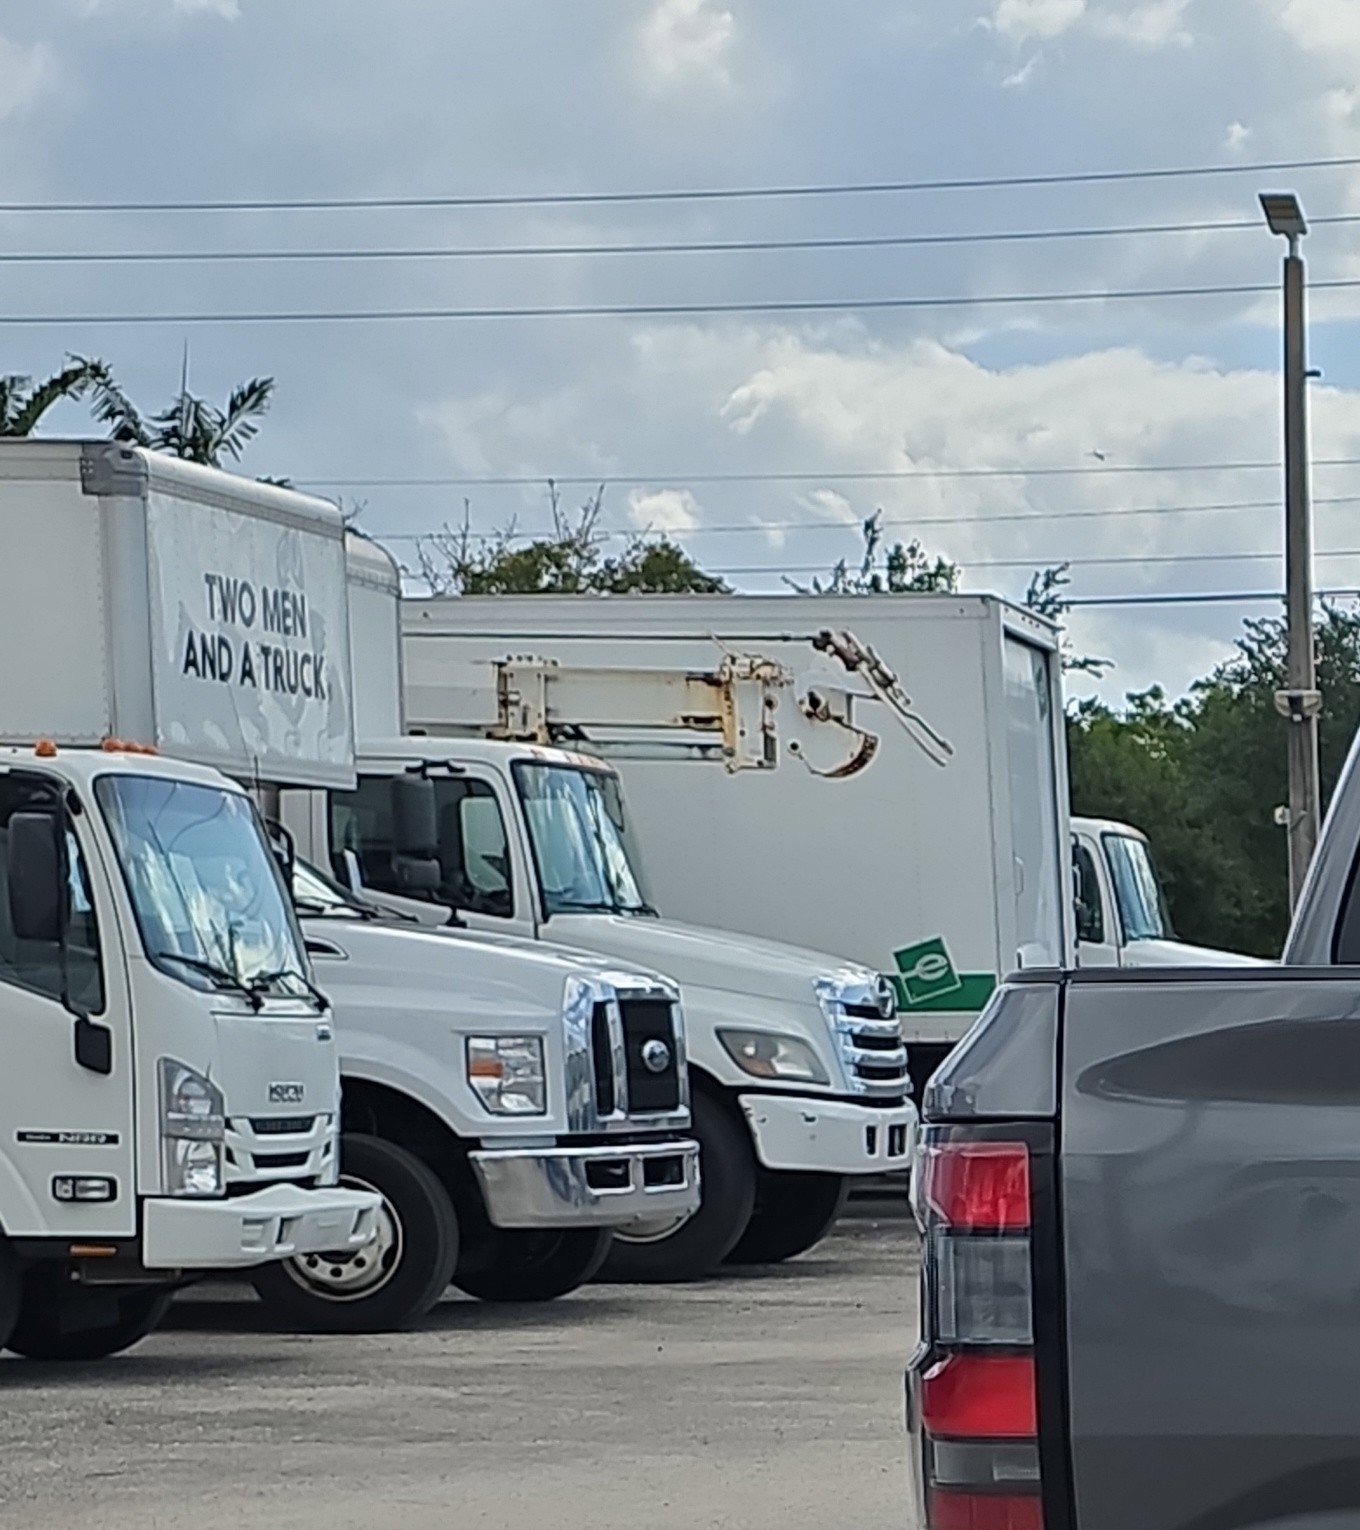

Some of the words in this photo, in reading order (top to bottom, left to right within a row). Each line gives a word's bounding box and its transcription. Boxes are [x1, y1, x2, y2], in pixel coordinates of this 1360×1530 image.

[204, 573, 256, 629] TWO
[261, 585, 307, 638] MEN
[182, 629, 233, 683] AND
[239, 641, 257, 688] A
[260, 643, 326, 700] TRUCK
